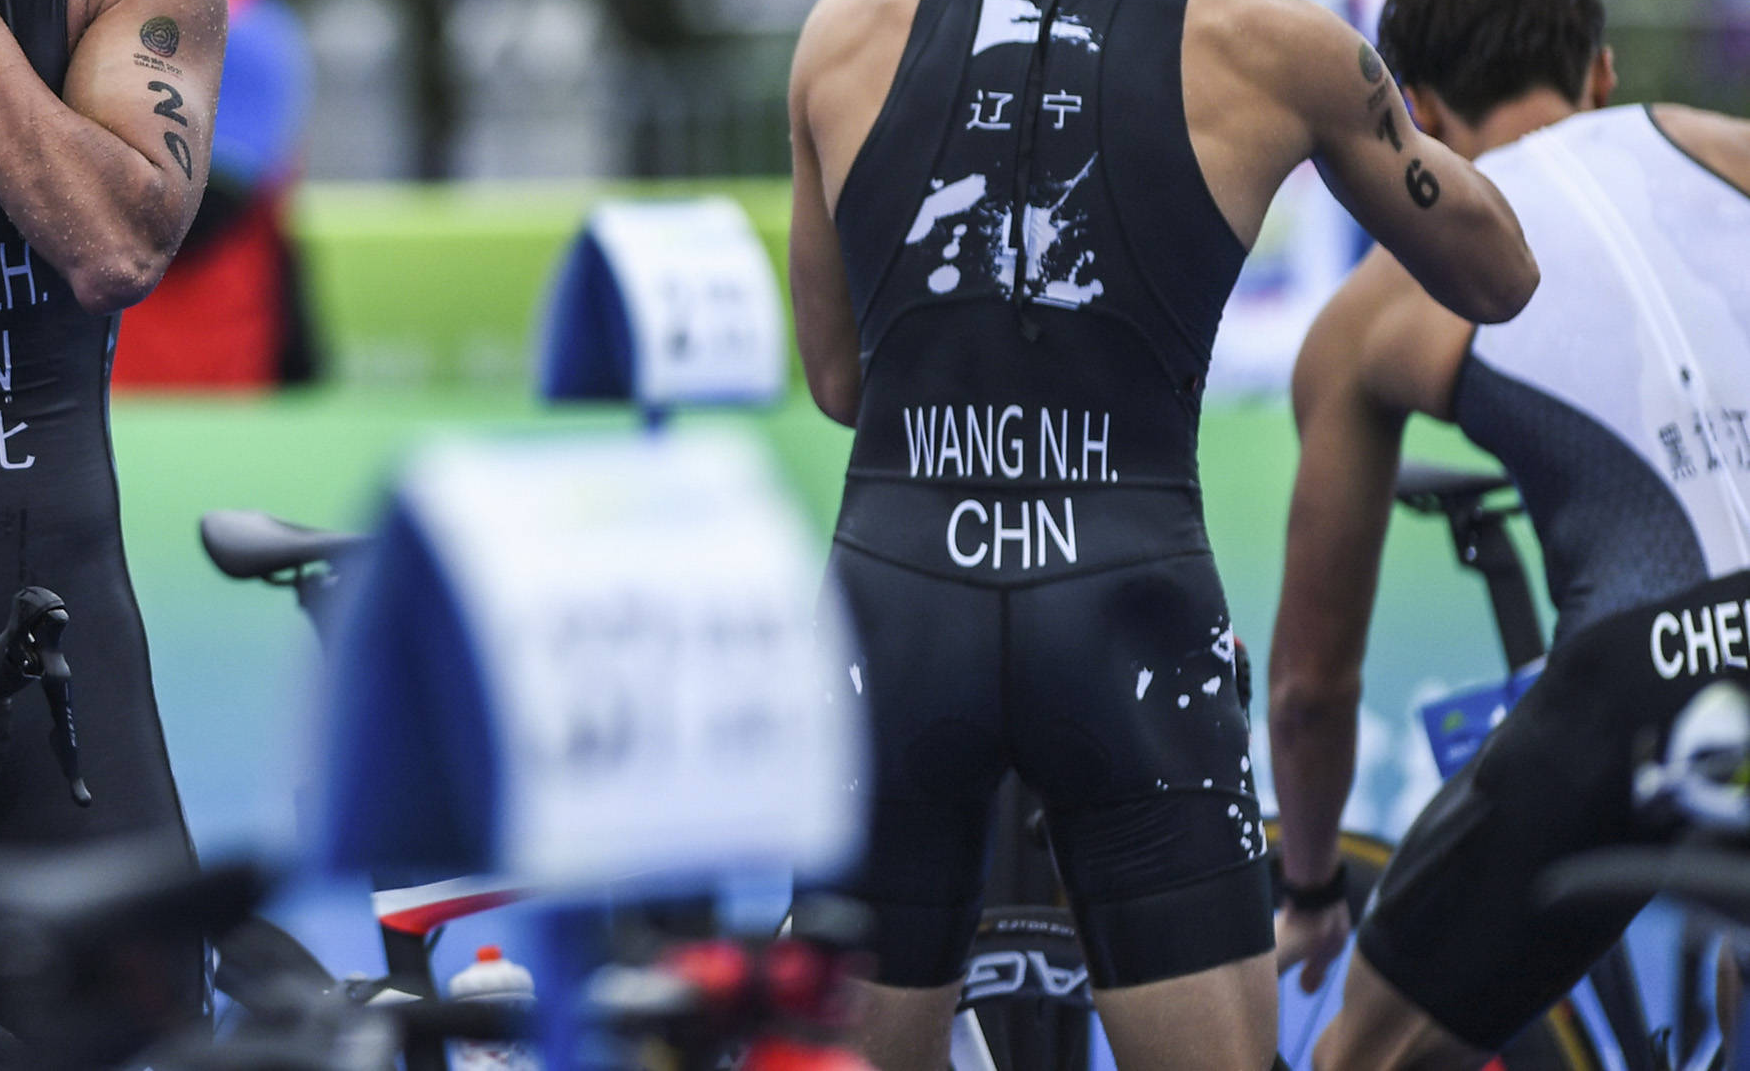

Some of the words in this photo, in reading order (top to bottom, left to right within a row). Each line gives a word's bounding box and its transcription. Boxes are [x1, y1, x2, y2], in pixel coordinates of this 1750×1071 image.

[965, 89, 1083, 130] 辽宁
[903, 404, 1024, 479] WANG
[1039, 406, 1119, 483] N.H.
[946, 497, 1078, 570] CHN
[1650, 598, 1750, 680] CHE
